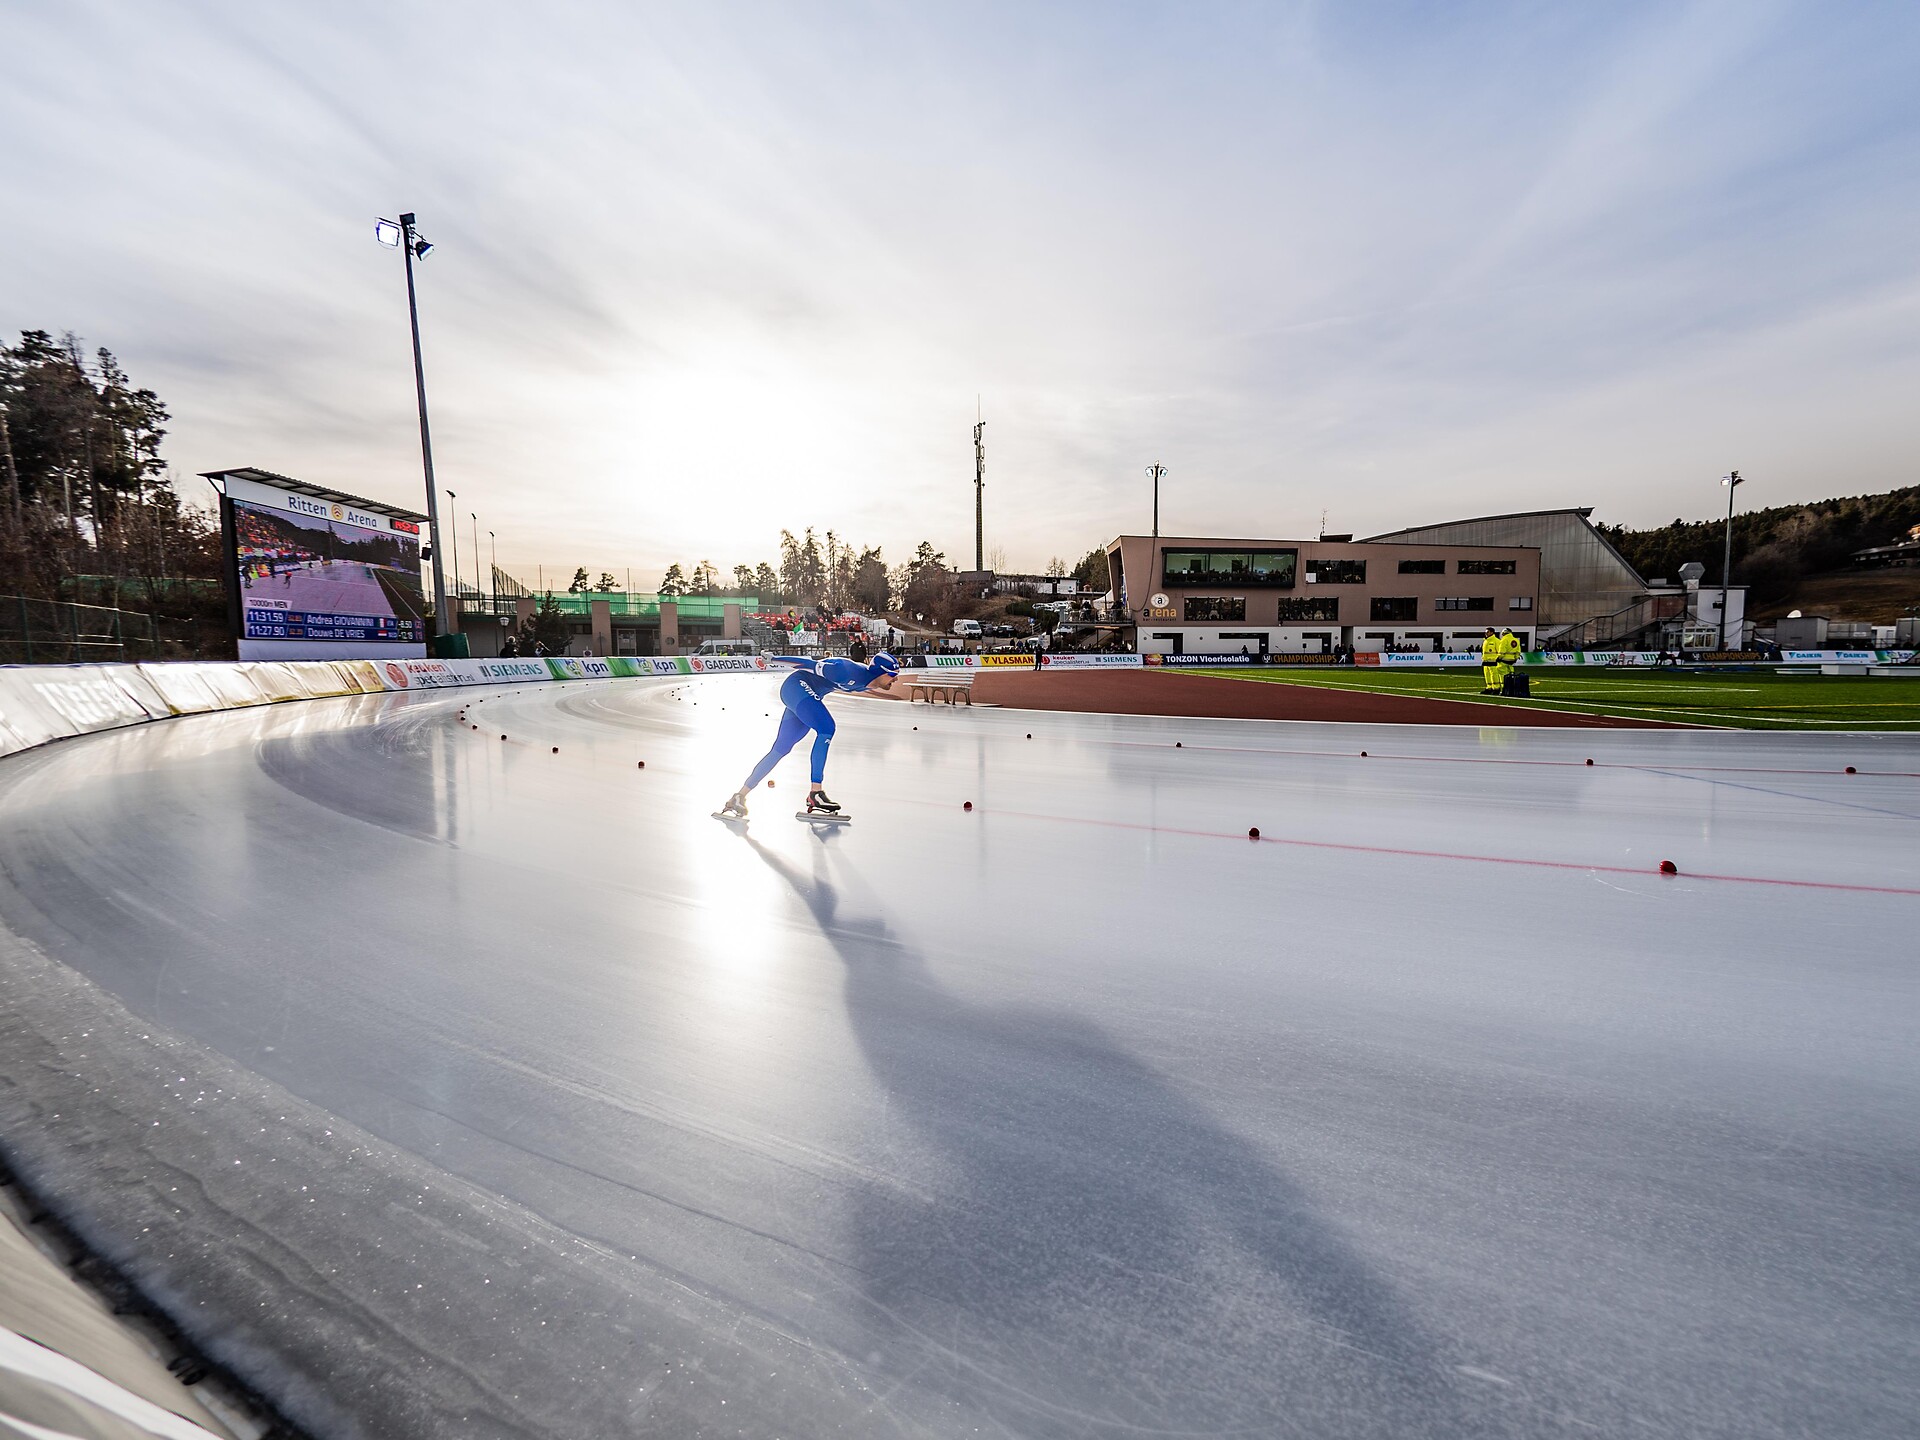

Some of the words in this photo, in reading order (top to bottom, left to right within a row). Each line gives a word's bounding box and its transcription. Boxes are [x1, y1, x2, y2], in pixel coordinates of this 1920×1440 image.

[288, 496, 327, 516] Ritten
[347, 512, 377, 528] Arena
[274, 600, 288, 609] MEN
[1143, 608, 1177, 617] arena
[307, 614, 333, 625] Andrea
[334, 616, 374, 627] GIOVANNINI
[308, 627, 334, 637] Douwe
[334, 628, 345, 638] DE
[345, 629, 365, 638] VRIES
[991, 656, 1034, 664] VLASMAN
[1166, 655, 1198, 663] TONZON
[1199, 655, 1250, 663] Vloerisolatie
[1273, 654, 1337, 663] CHAMPIONSHIPS
[1556, 653, 1574, 661] kpn
[1702, 652, 1762, 660] CHAMPIONSHIPS
[405, 662, 446, 674] keuken
[581, 660, 609, 675] kpn
[652, 659, 677, 672] kpn
[705, 660, 752, 670] GARDENA
[490, 664, 543, 677] SIEMENS
